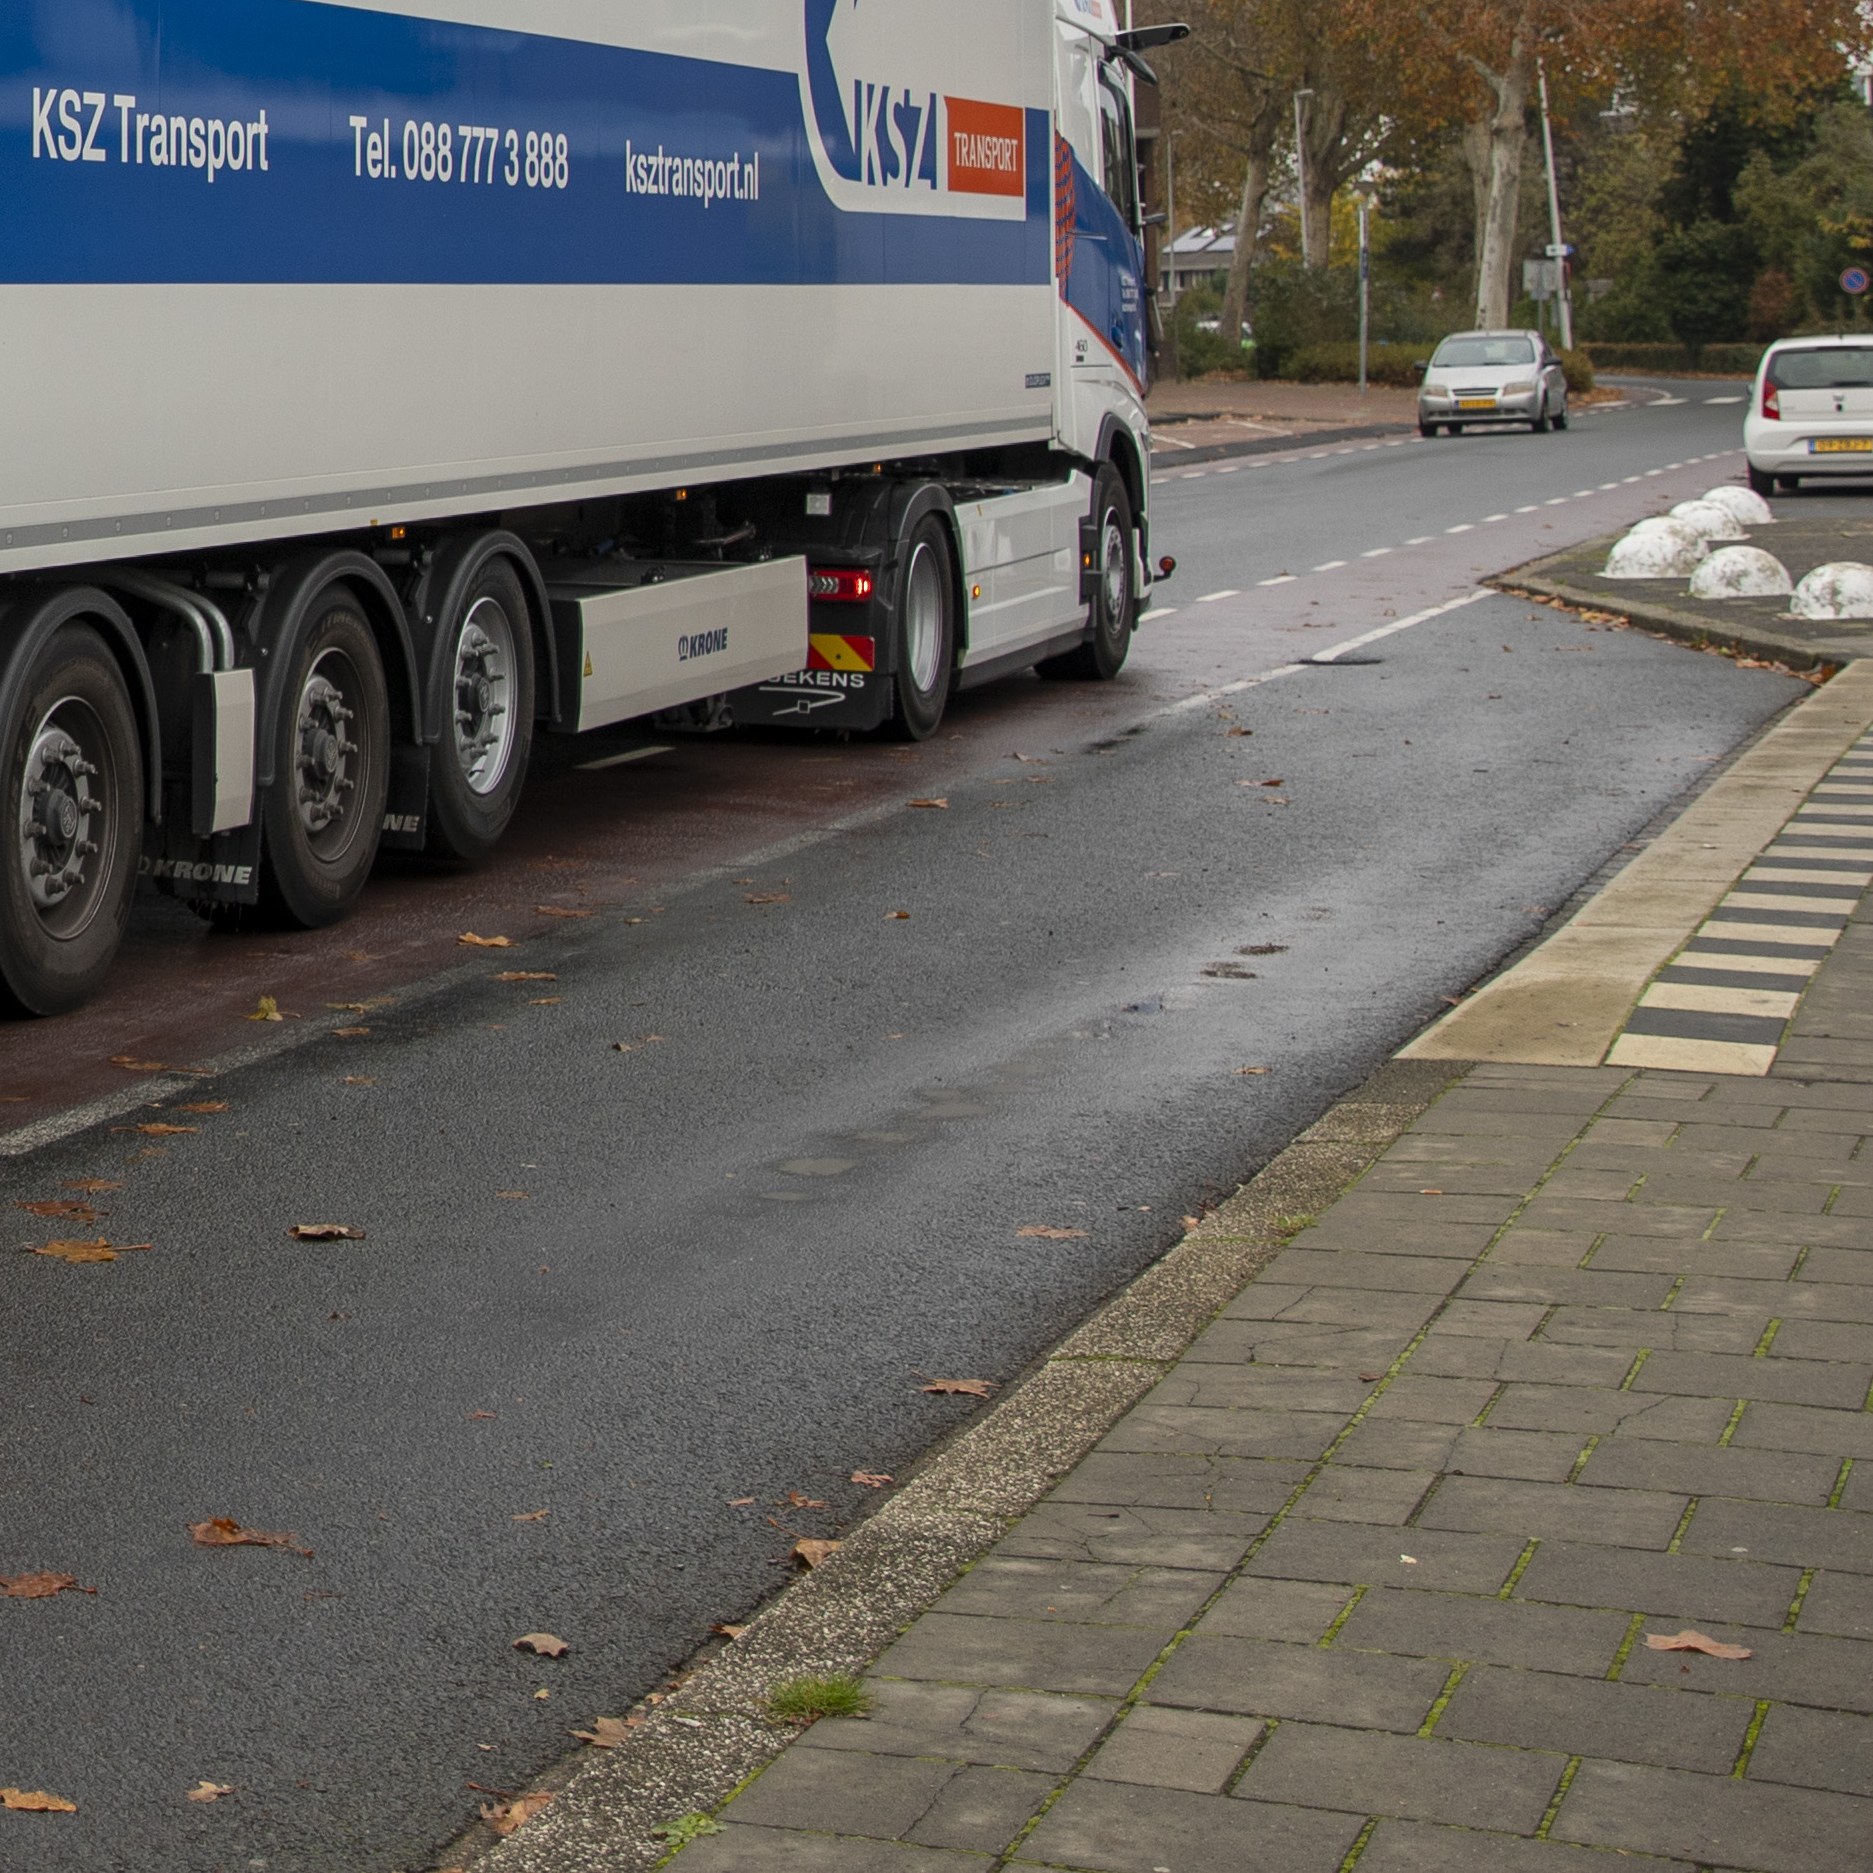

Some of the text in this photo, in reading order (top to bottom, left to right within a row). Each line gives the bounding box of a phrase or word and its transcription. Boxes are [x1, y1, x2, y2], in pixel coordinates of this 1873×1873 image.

[32, 87, 269, 183] KSZ Transport
[349, 115, 569, 189] Tel. 088 777 3 888
[861, 79, 1018, 190] KSZ TRANSPORT
[625, 139, 759, 208] ksztransport.nl
[689, 628, 728, 658] KRONE
[153, 859, 252, 886] KRONE
